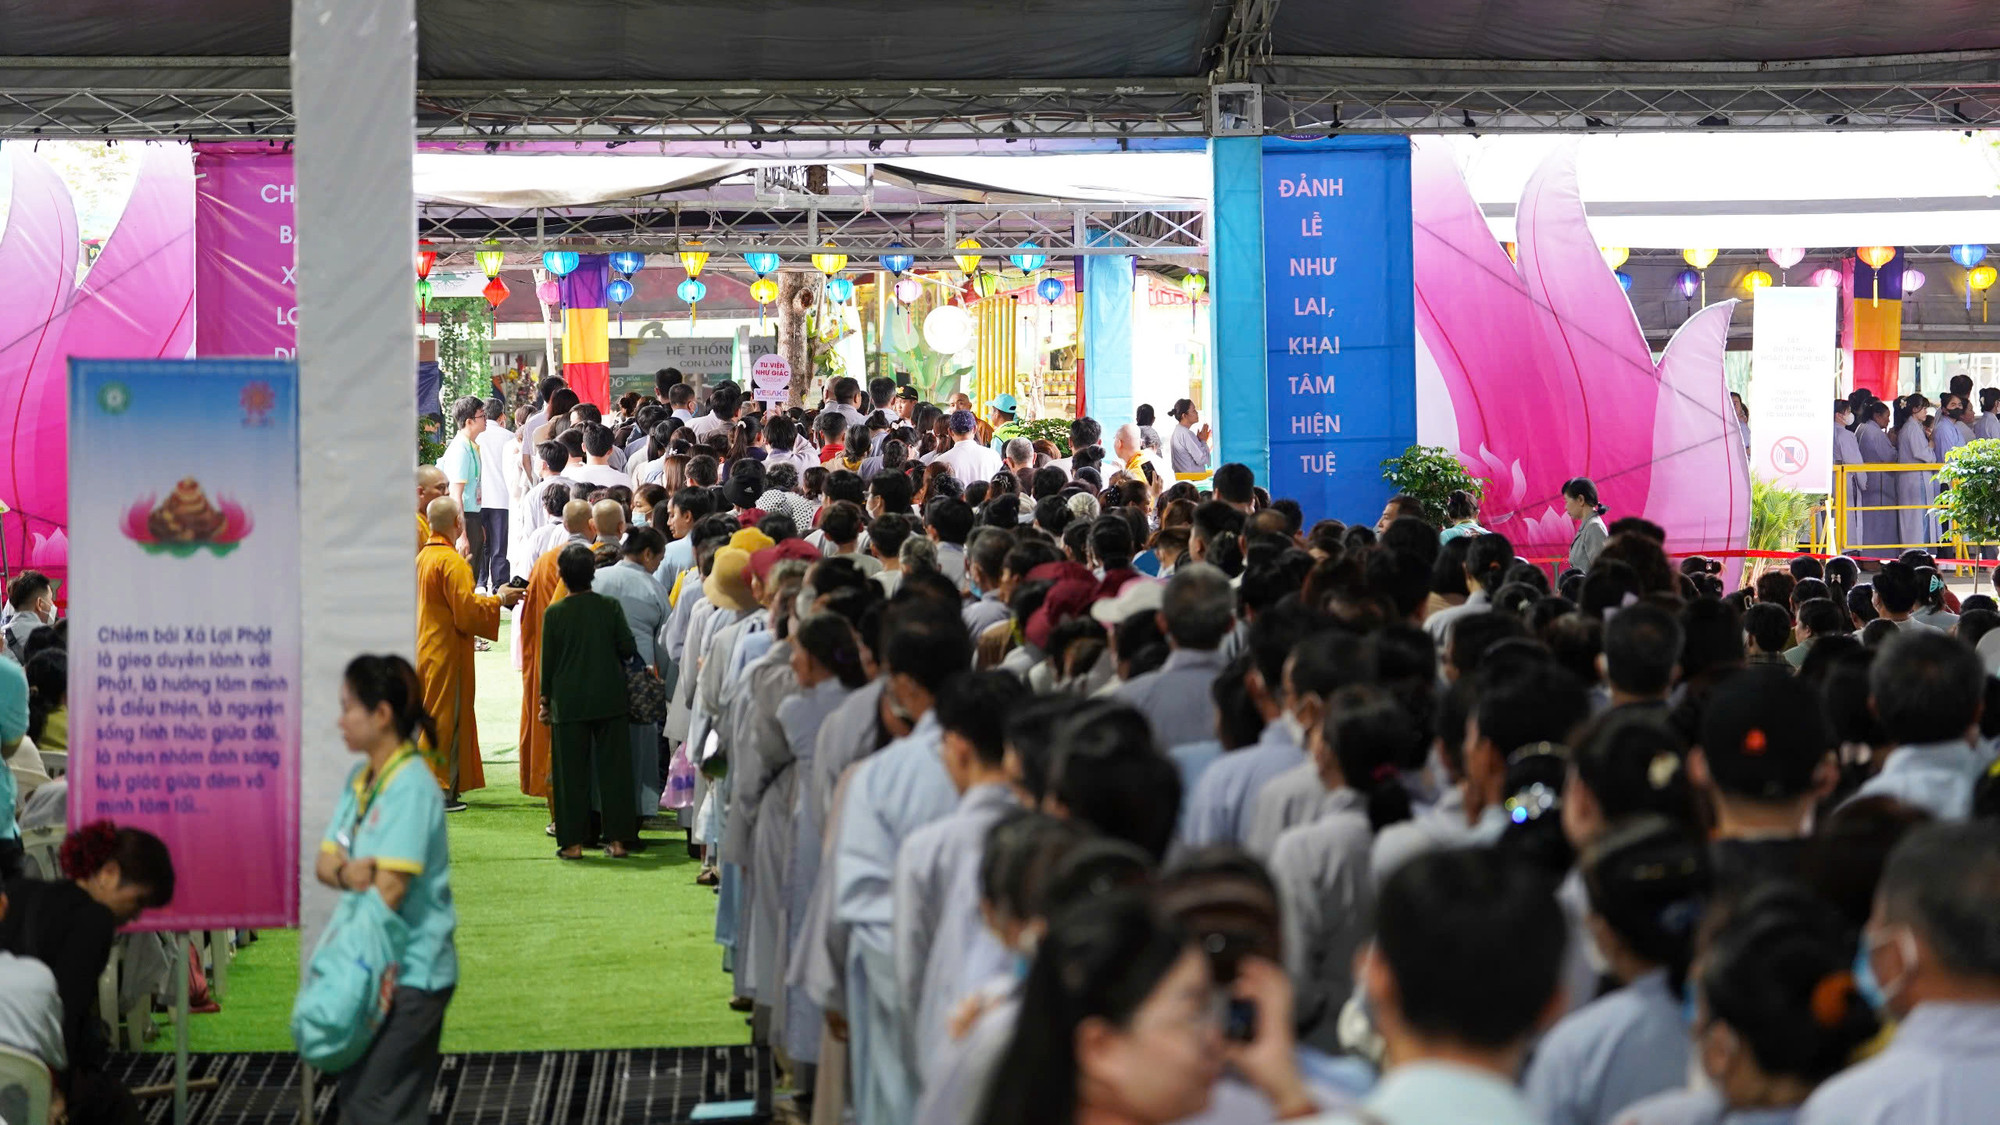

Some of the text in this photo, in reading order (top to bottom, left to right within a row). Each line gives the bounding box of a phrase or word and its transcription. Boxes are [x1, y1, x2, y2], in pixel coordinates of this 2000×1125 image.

[1278, 173, 1343, 198] ĐẢNH
[1301, 211, 1322, 237] LỄ
[1290, 257, 1338, 277] NHƯ
[1294, 296, 1335, 318] LAI,
[1288, 336, 1340, 355] KHAI
[1288, 373, 1335, 395] TÂM
[1292, 411, 1341, 436] HIỆN
[1300, 451, 1337, 477] TUỆ
